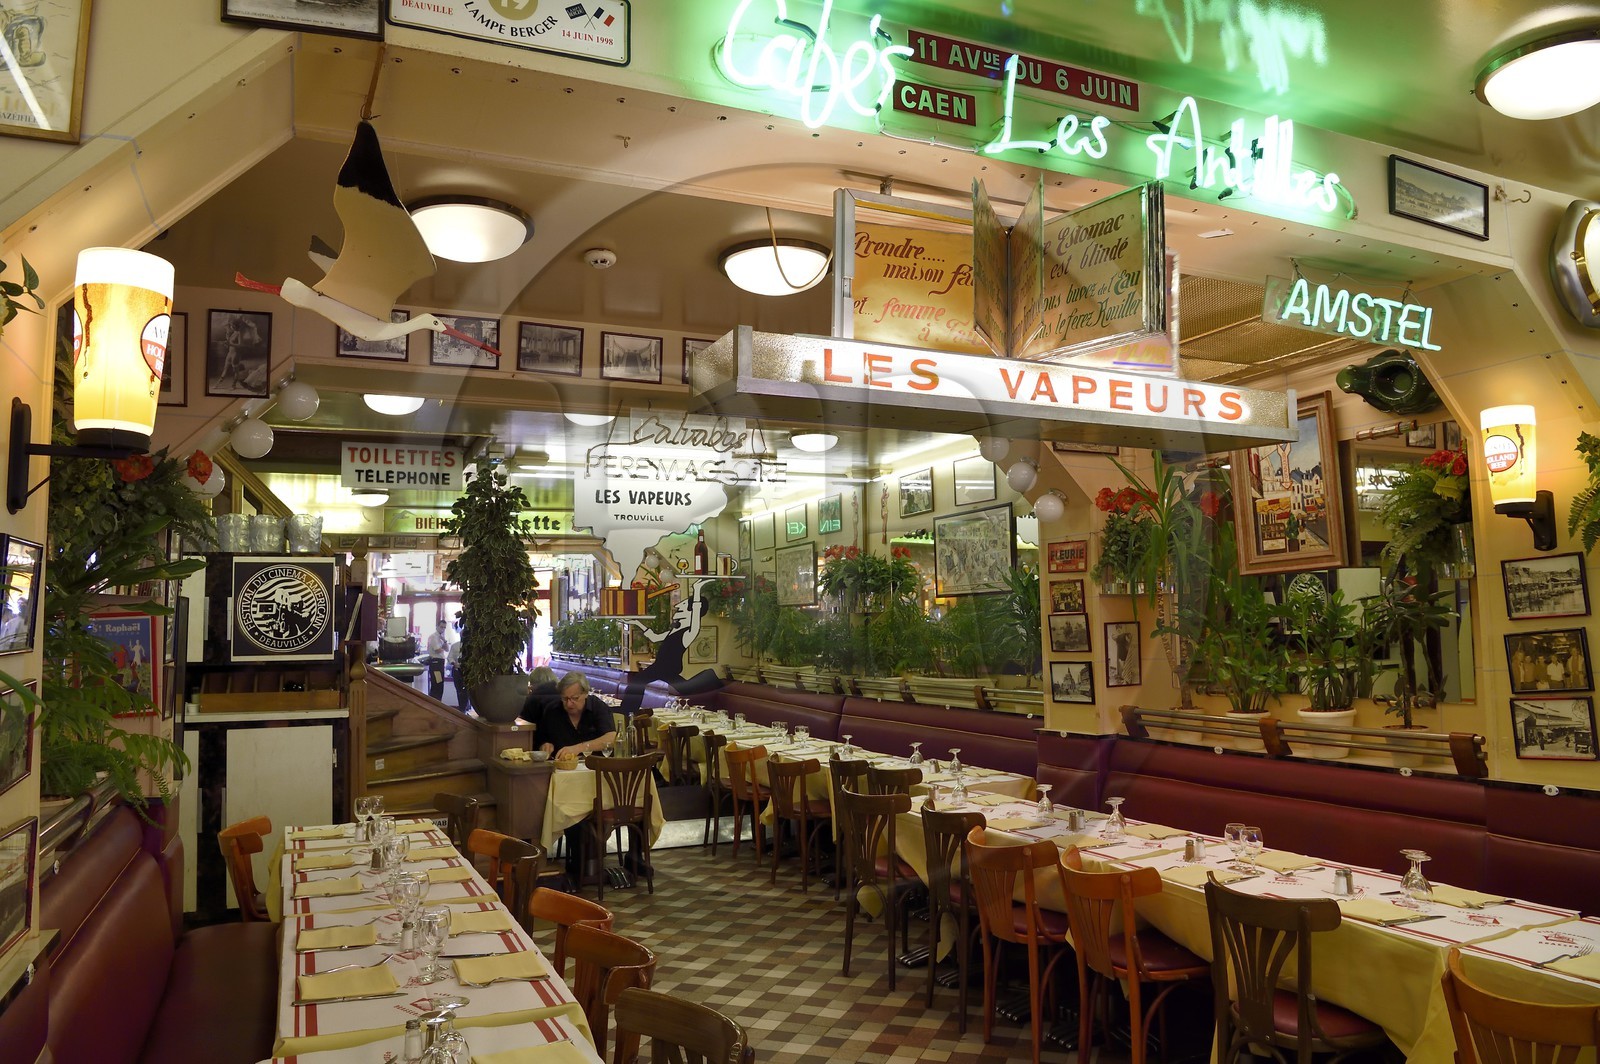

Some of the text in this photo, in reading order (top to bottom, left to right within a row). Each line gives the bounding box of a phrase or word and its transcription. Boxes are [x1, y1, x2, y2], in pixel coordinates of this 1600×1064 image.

[401, 0, 453, 16] DEAUVILLE
[464, 1, 558, 37] LAMPE BERGER
[562, 30, 614, 46] 14 JUIN 1998
[917, 37, 938, 62] 11
[1015, 61, 1043, 85] DU
[1056, 68, 1069, 91] 6
[1081, 75, 1132, 106] JUIN
[901, 85, 968, 120] CAEN
[985, 53, 1111, 160] Les
[1057, 213, 1126, 257] Estomac
[883, 263, 945, 283] maison
[1050, 236, 1129, 280] est blindé
[873, 297, 945, 323] femme
[1043, 293, 1061, 312] ous
[1066, 282, 1097, 305] buvez
[1061, 308, 1094, 341] ferez
[1092, 290, 1143, 328] Rouiller
[1282, 278, 1442, 352] AMSTEL
[823, 348, 1244, 421] LES VAPEURS
[632, 412, 748, 453] Calvados
[347, 447, 456, 468] TOILETTES
[595, 489, 692, 506] LES VAPEURS
[1050, 548, 1084, 561] FLEURIE
[241, 568, 327, 631] FESTIVAL DU CINEMA AMERICAIN
[105, 622, 141, 633] Raphaël
[259, 634, 309, 648] DEAUVILLE
